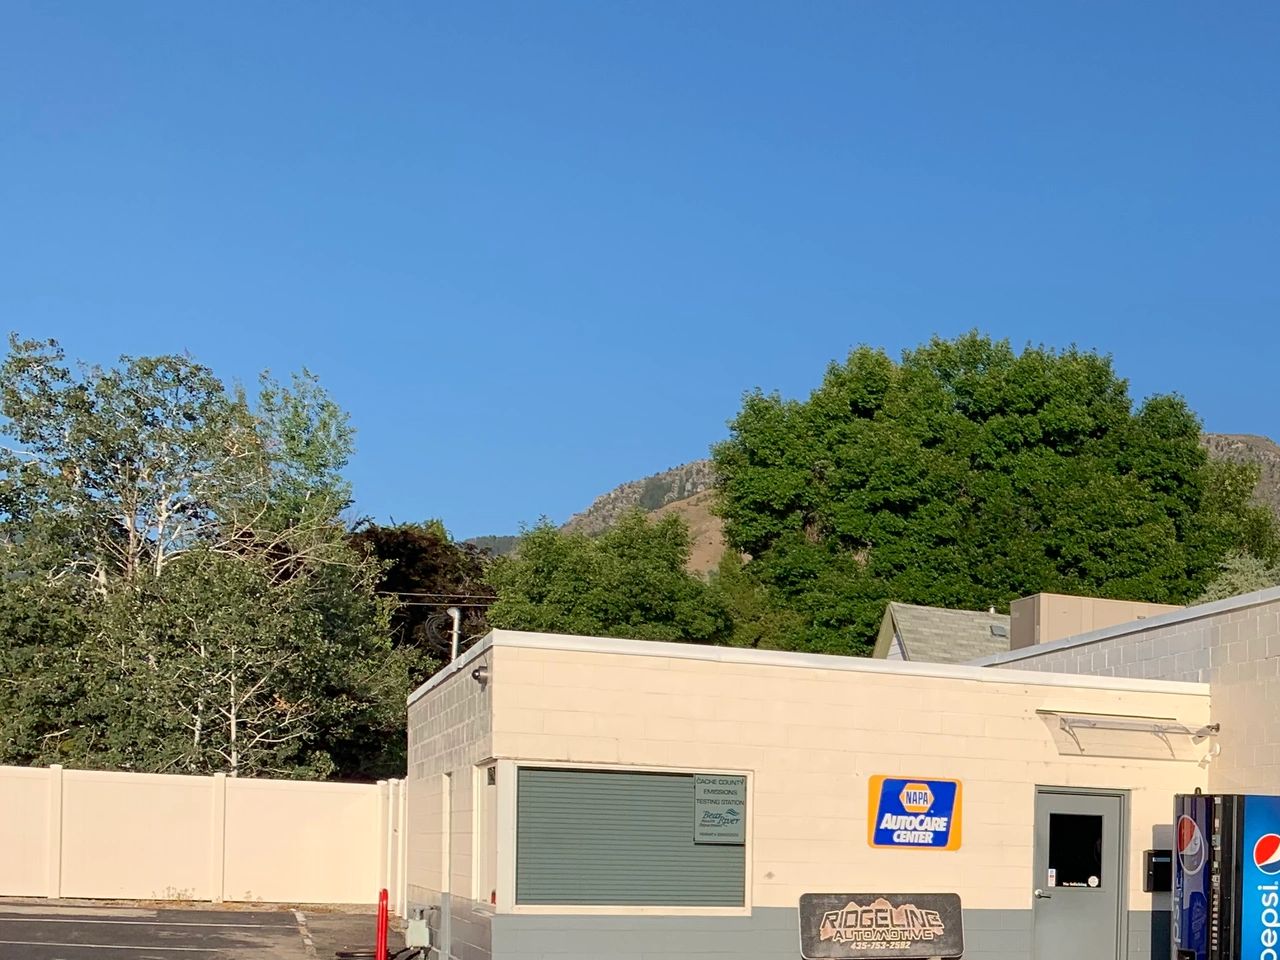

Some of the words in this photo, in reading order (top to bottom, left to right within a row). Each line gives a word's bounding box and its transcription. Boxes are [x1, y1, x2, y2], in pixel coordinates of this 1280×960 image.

[905, 791, 929, 805] NAPA
[893, 831, 934, 843] CENTER
[820, 908, 945, 930] RIDGELINE
[832, 929, 935, 942] AUTOMOTIVE
[850, 940, 911, 950] 435-753-2592
